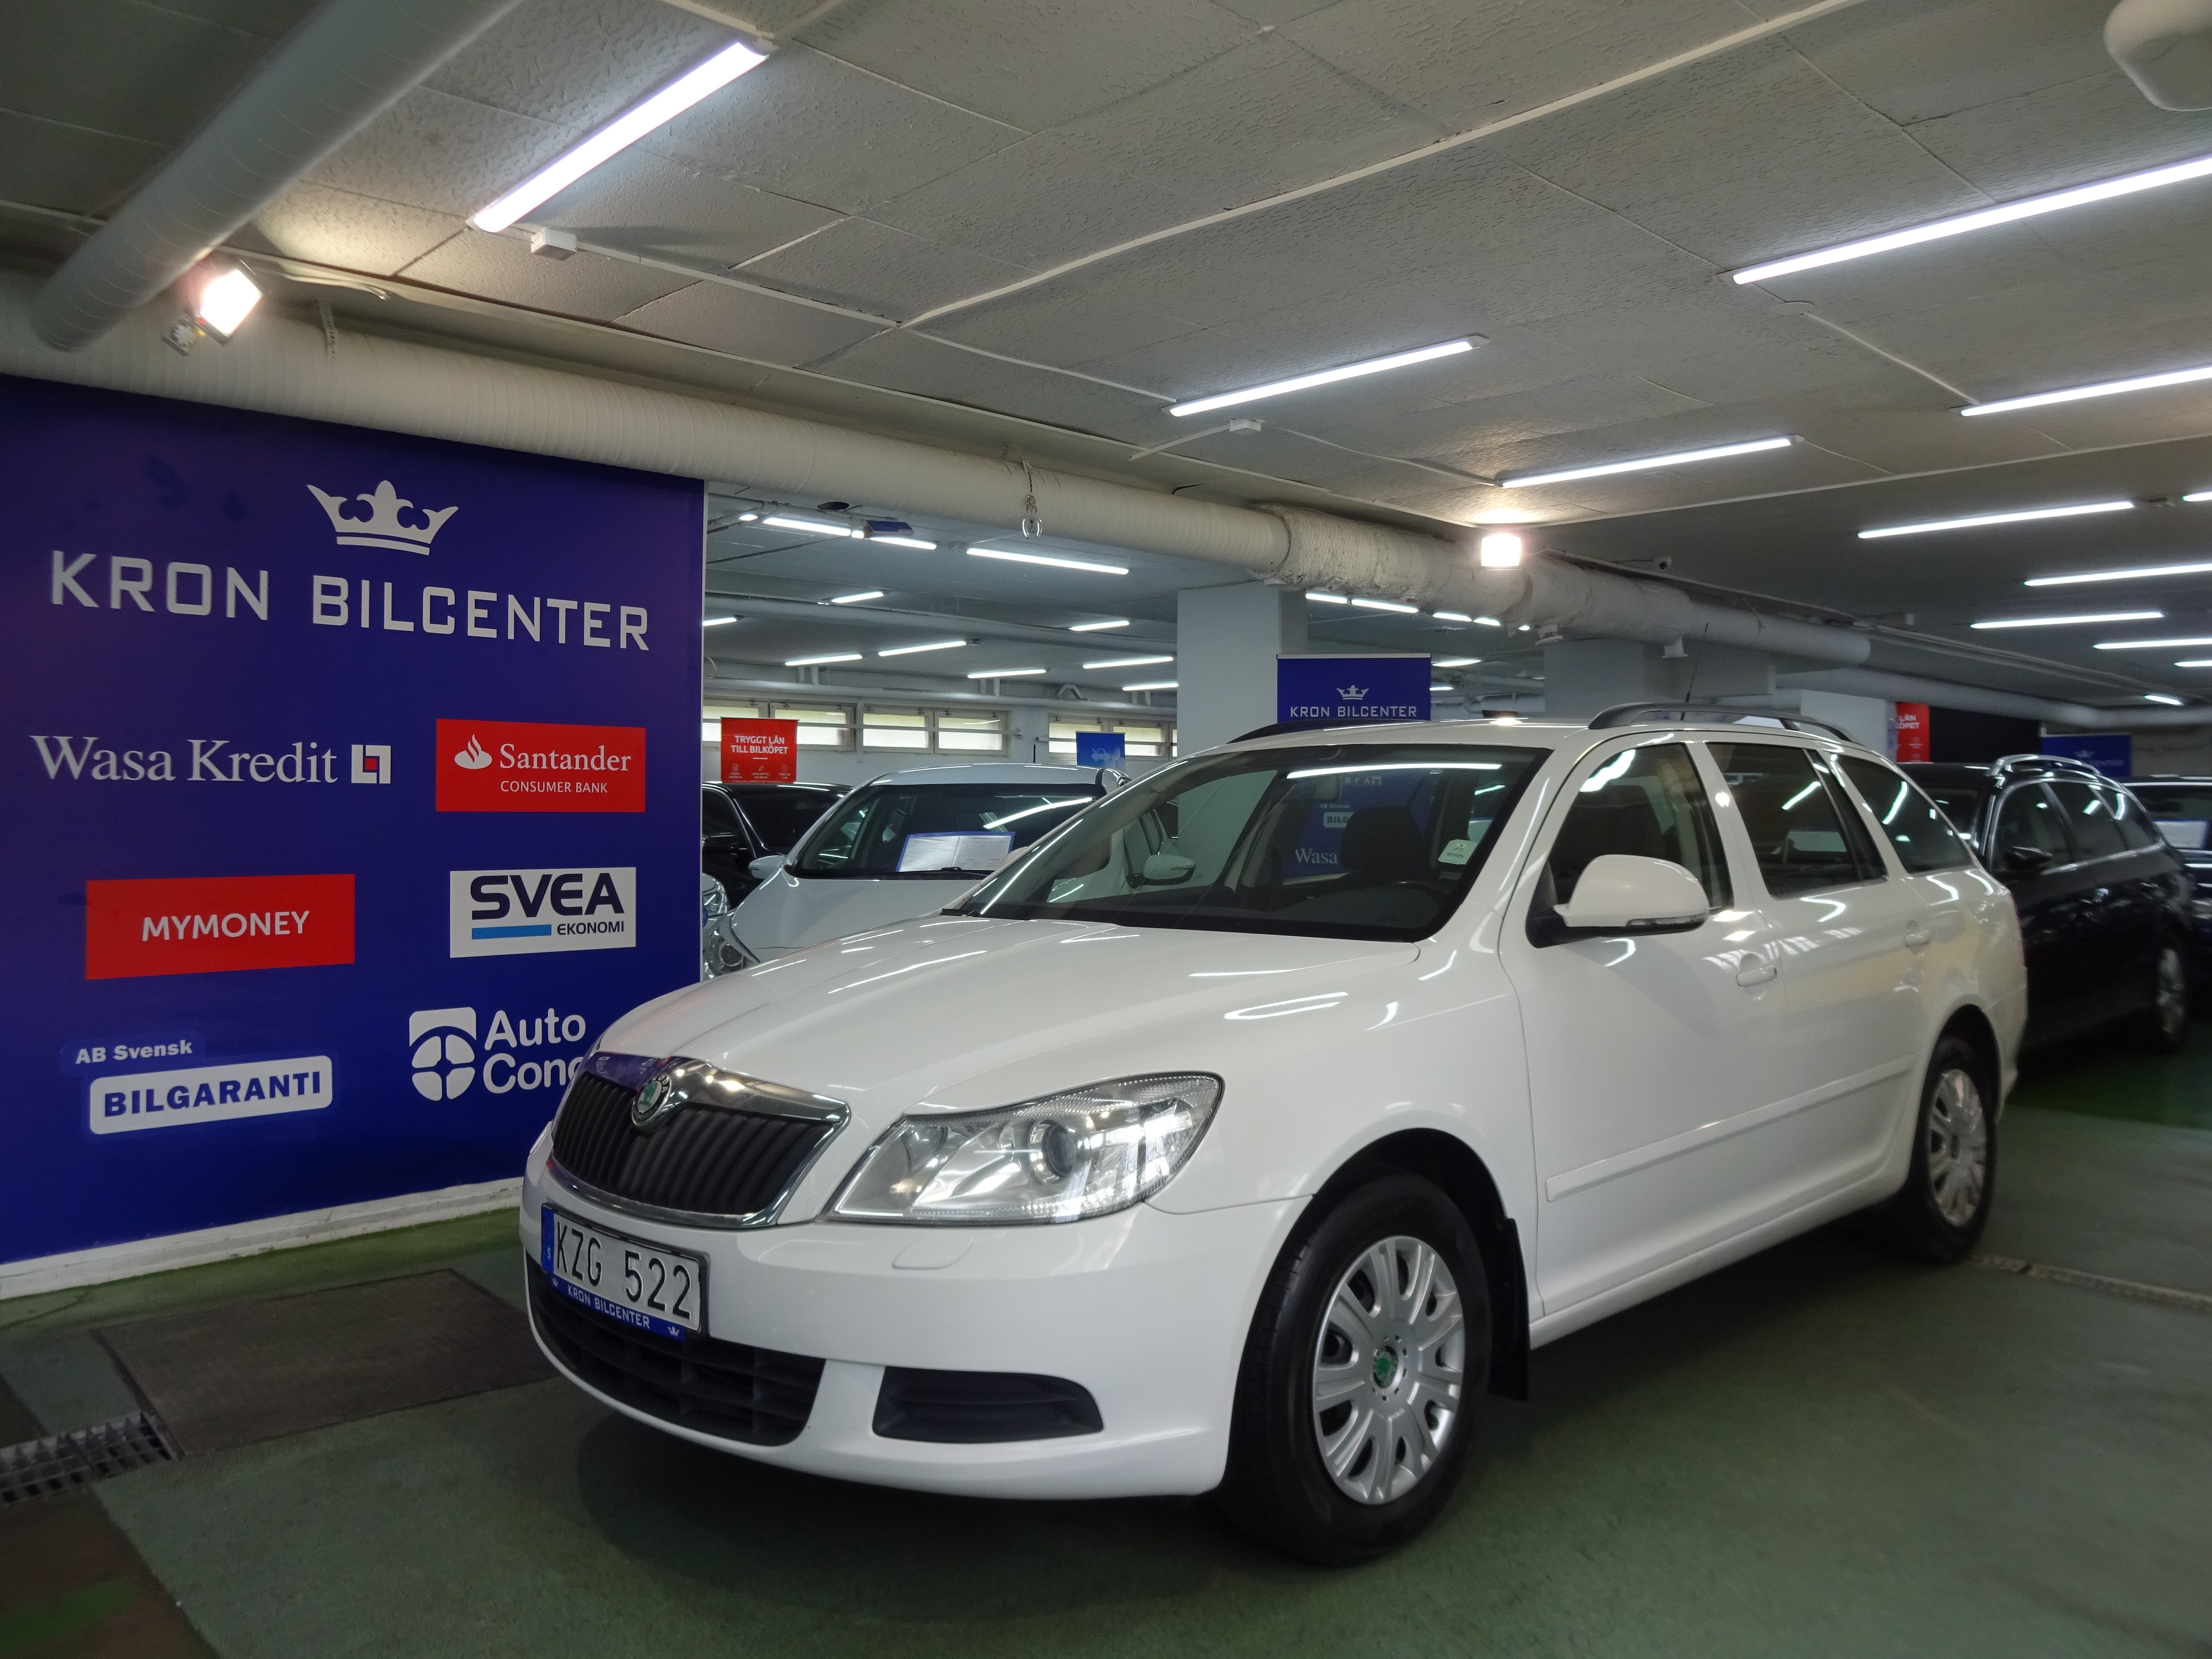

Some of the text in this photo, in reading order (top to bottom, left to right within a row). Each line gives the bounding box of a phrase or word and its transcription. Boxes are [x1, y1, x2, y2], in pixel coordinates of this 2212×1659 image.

[52, 551, 650, 651] KRON BILCENTER
[1290, 706, 1416, 717] KRON BILCENTER
[735, 735, 784, 744] TRYGGT LÅN
[750, 745, 788, 754] BILKÖPET
[29, 736, 338, 783] Wasa Kredit
[500, 743, 631, 771] Santander
[501, 781, 608, 793] CONSUMER BANK
[1295, 848, 1338, 864] Wasa
[470, 873, 624, 920] SVEA
[141, 910, 310, 942] MYMONEY
[557, 921, 624, 935] EKONOMI
[484, 1008, 586, 1050] Auto
[75, 1040, 192, 1064] AB Svensk
[104, 1071, 320, 1117] BILGARANTI
[547, 1247, 551, 1260] S
[557, 1222, 690, 1319] KZG 522
[568, 1284, 650, 1329] KRON BILCENTER
